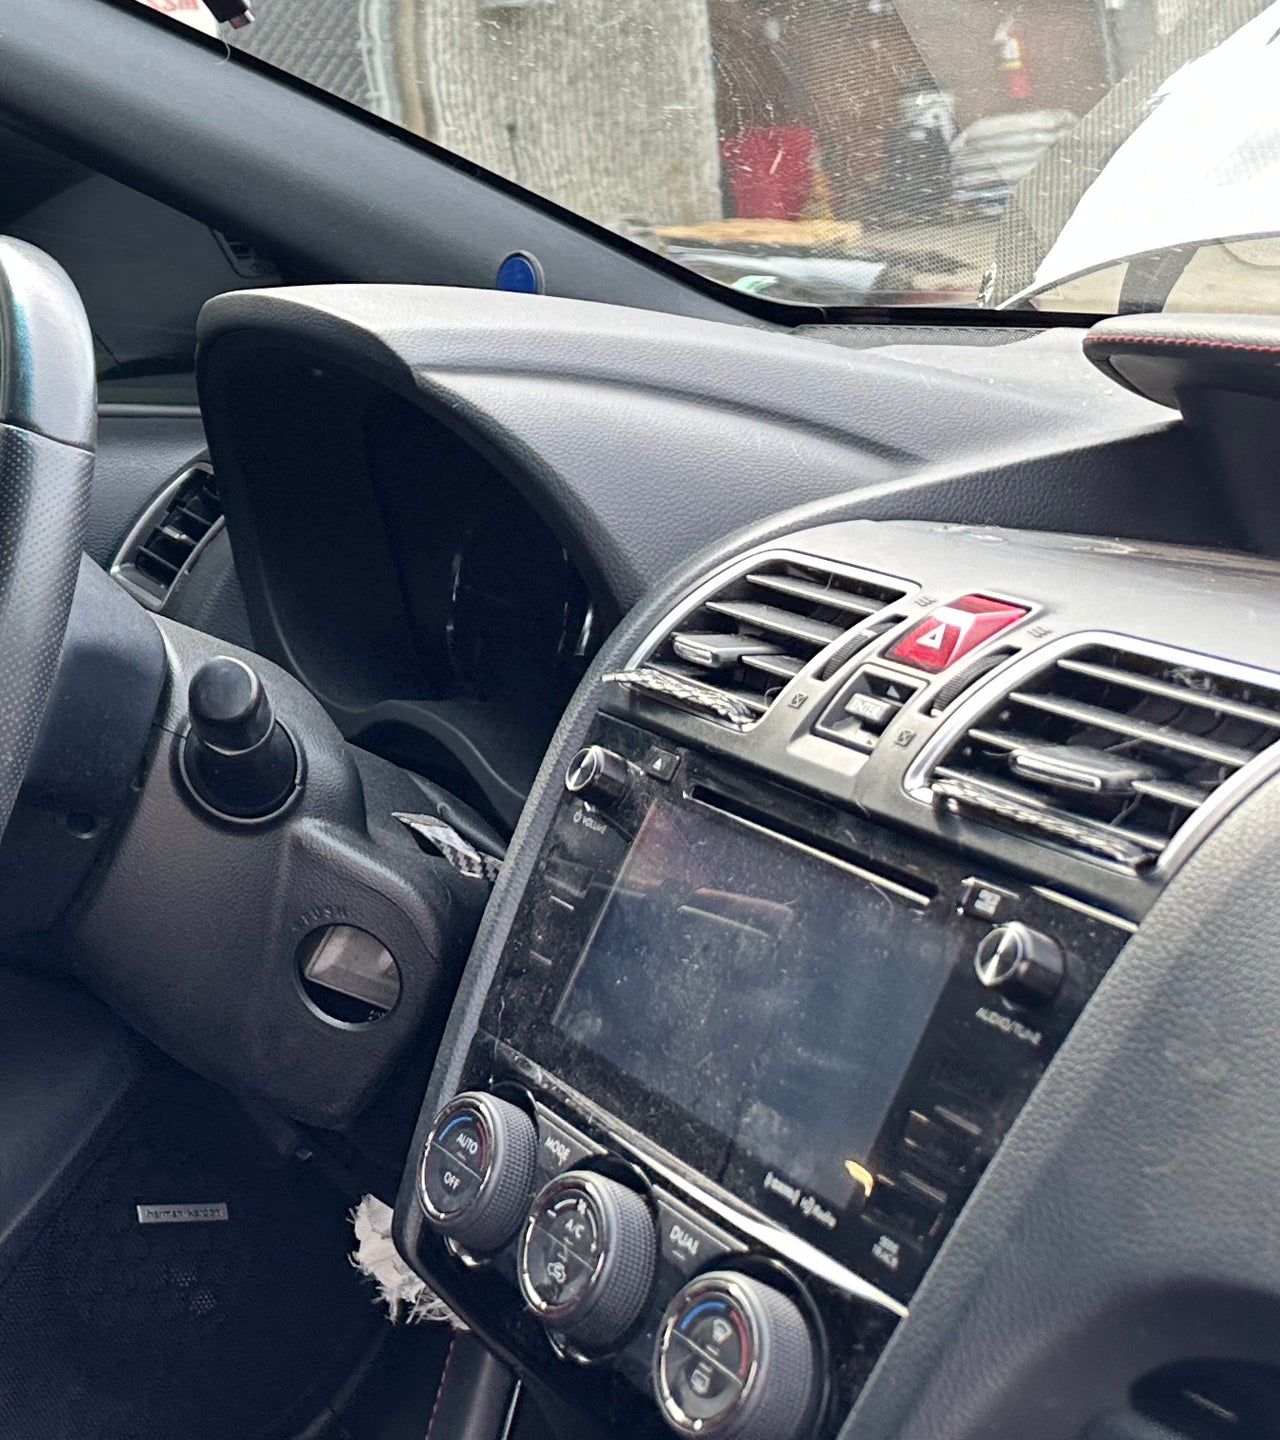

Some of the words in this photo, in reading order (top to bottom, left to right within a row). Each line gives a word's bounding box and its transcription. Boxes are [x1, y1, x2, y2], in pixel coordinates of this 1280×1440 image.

[456, 1133, 479, 1155] AUTO
[544, 1136, 571, 1162] MODE
[443, 1171, 461, 1190] OFF
[564, 1218, 585, 1239] A/C
[669, 1224, 700, 1256] DUAL
